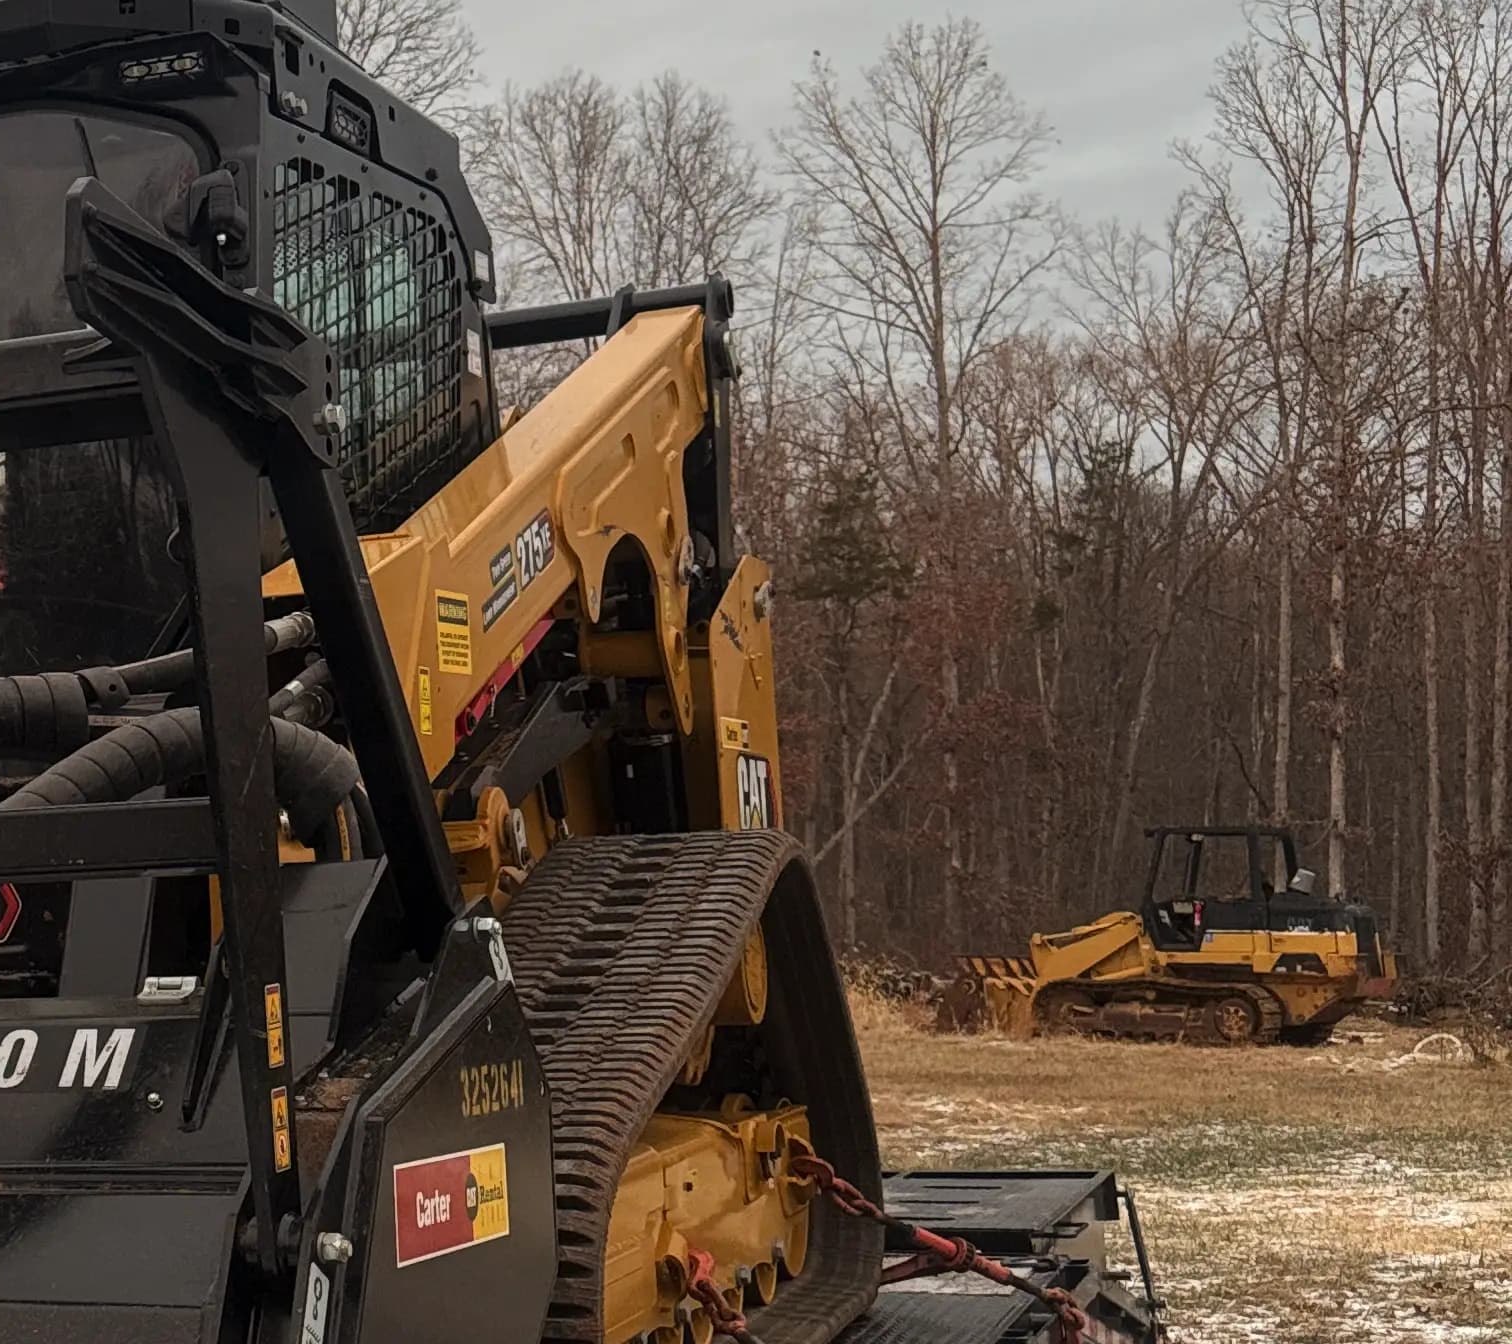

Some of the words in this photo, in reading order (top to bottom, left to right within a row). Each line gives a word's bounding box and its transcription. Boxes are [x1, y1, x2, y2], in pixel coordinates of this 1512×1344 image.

[737, 755, 768, 830] CAT
[58, 1028, 136, 1090] M
[460, 1059, 524, 1118] 3252641
[416, 1189, 451, 1229] Carter
